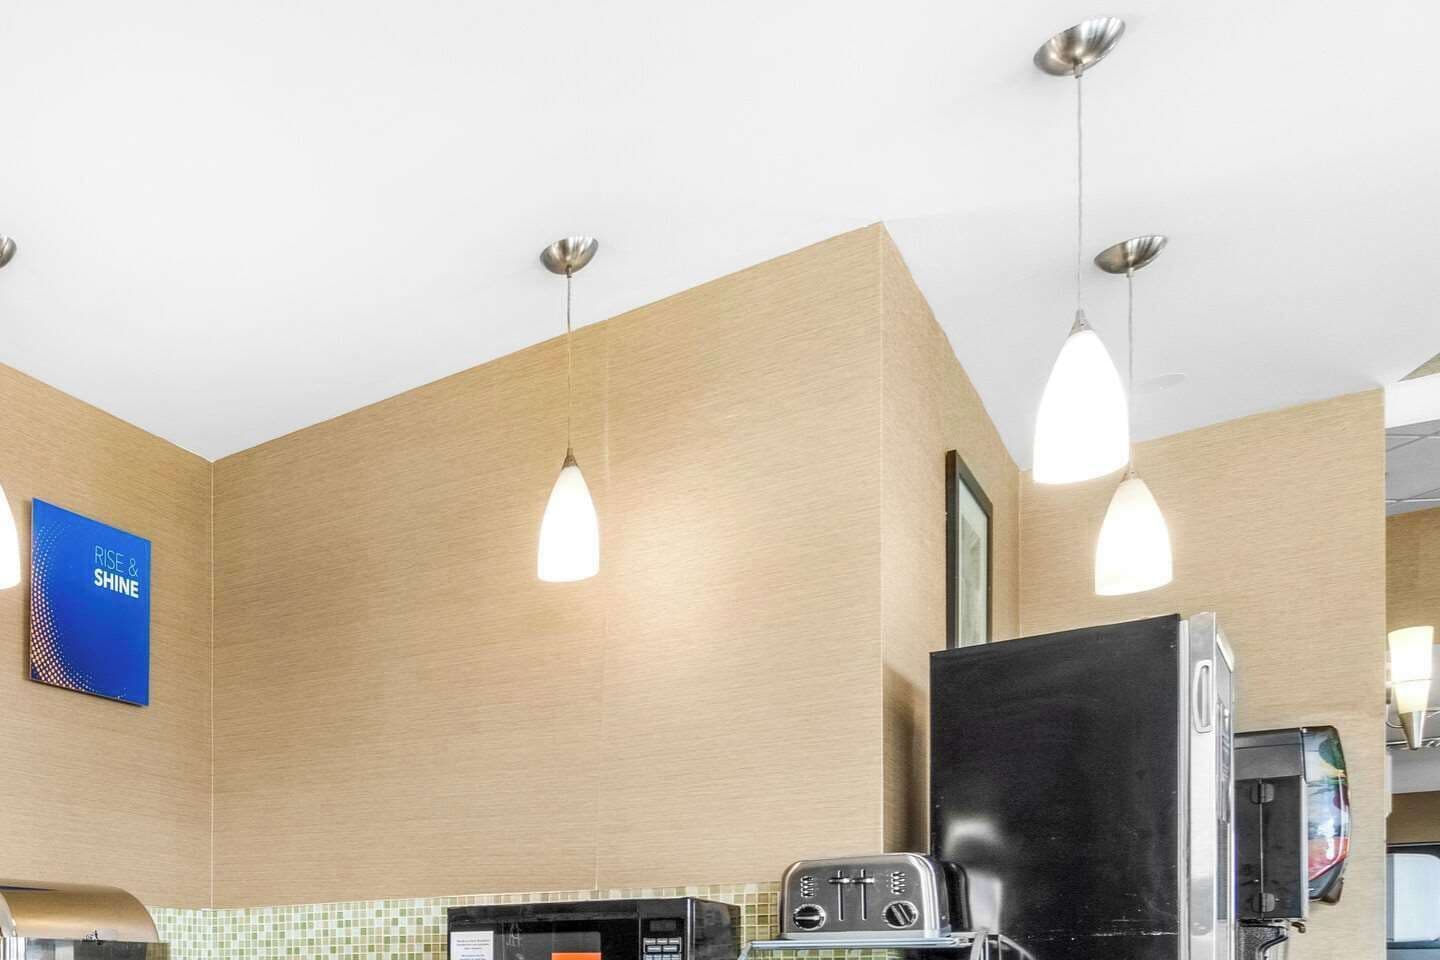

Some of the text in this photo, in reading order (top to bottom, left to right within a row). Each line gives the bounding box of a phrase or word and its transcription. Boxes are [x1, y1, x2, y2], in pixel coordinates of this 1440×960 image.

[94, 545, 138, 577] RISE &
[94, 568, 140, 599] SHINE
